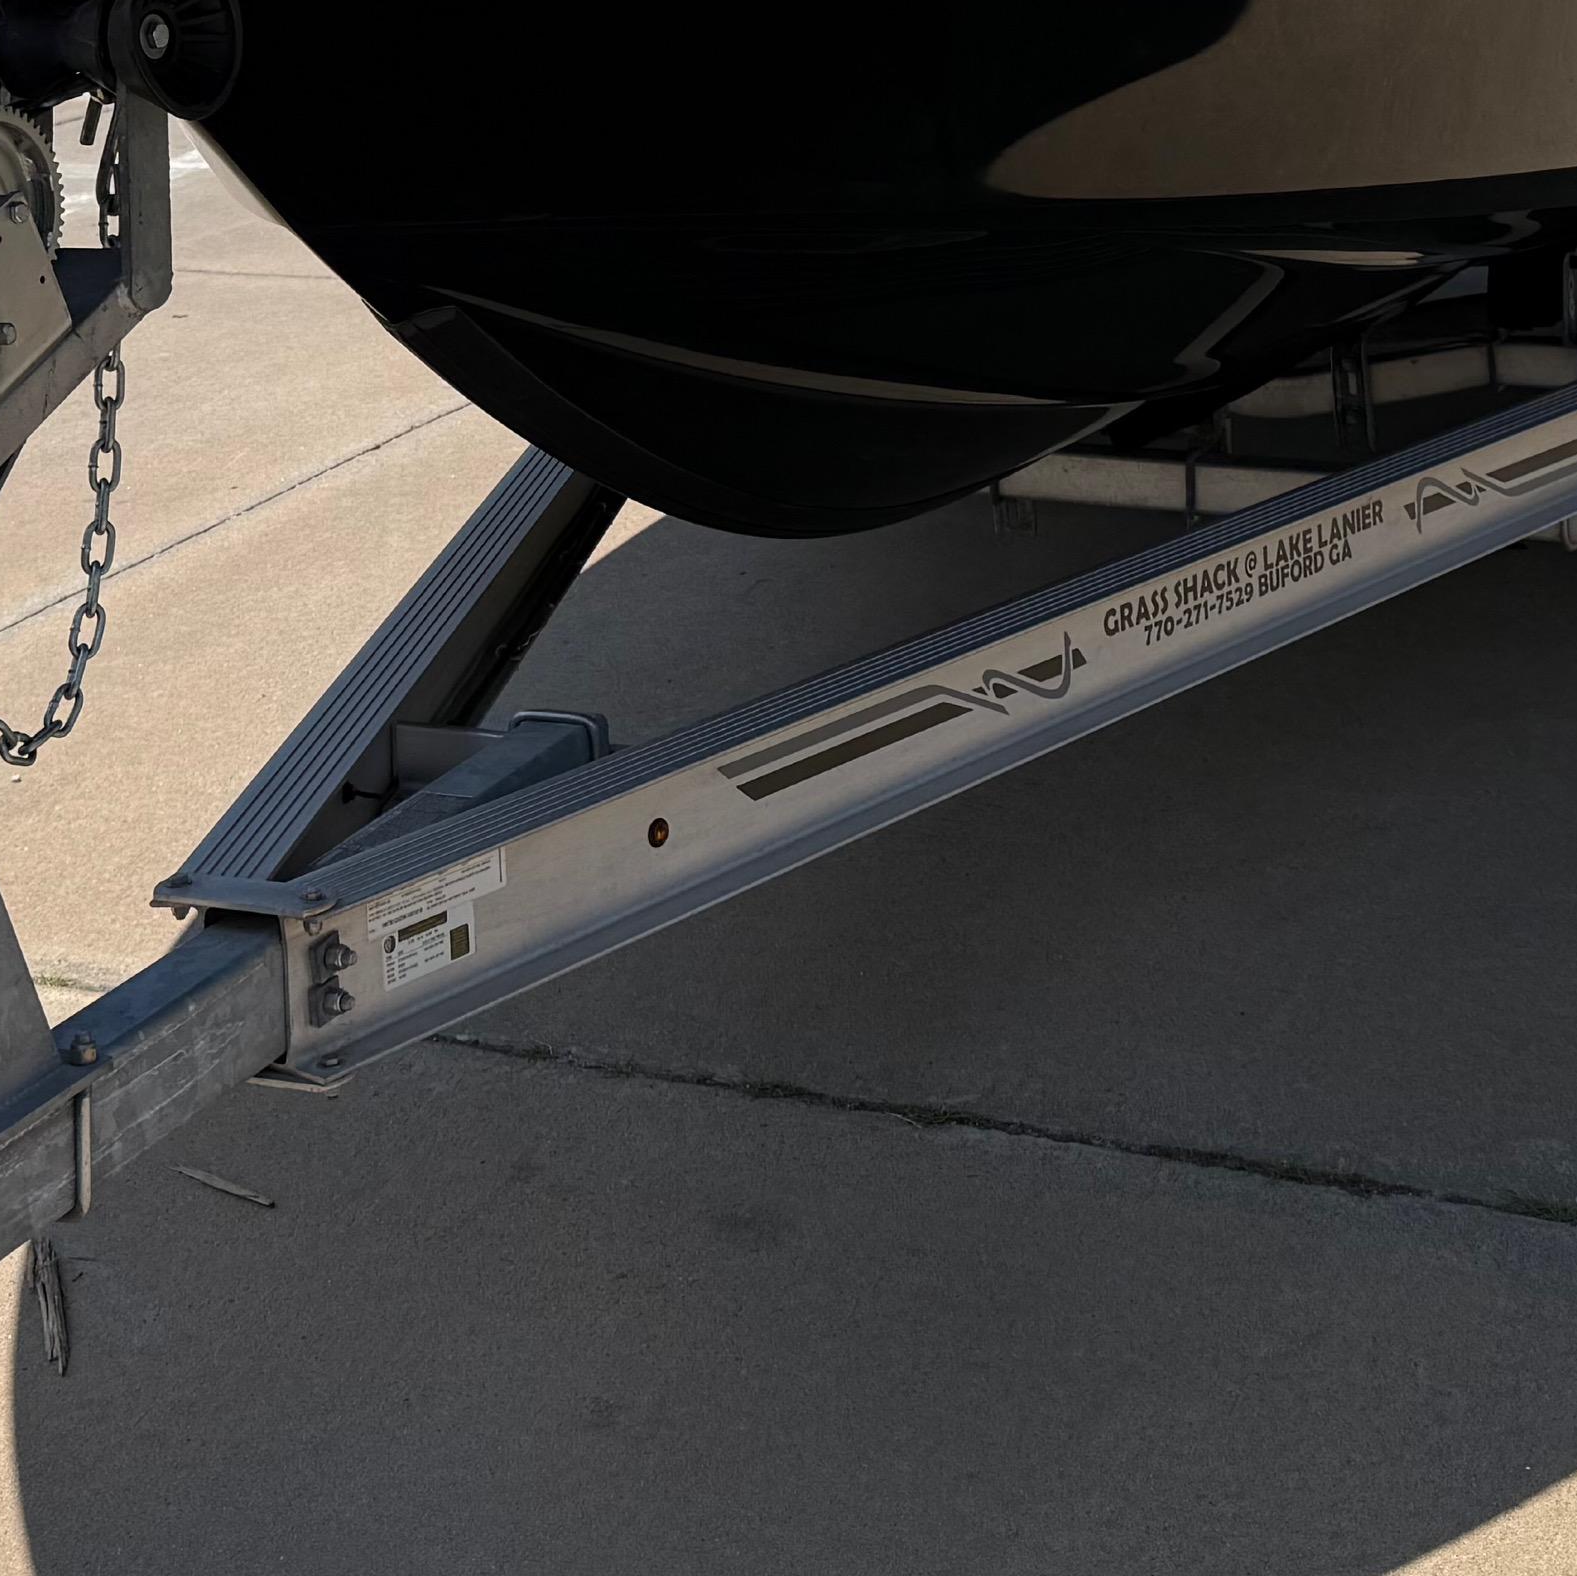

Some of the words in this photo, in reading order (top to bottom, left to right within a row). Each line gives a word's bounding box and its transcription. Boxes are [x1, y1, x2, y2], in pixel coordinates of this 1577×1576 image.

[1104, 586, 1169, 637] GRASS
[1174, 557, 1239, 609] SHACK
[1244, 551, 1257, 578] @
[1263, 528, 1313, 571] LAKE
[1318, 499, 1384, 550] LANIER
[1144, 582, 1254, 646] 770-271-7529
[1258, 552, 1324, 598] BUFORD
[1329, 539, 1352, 566] GA
